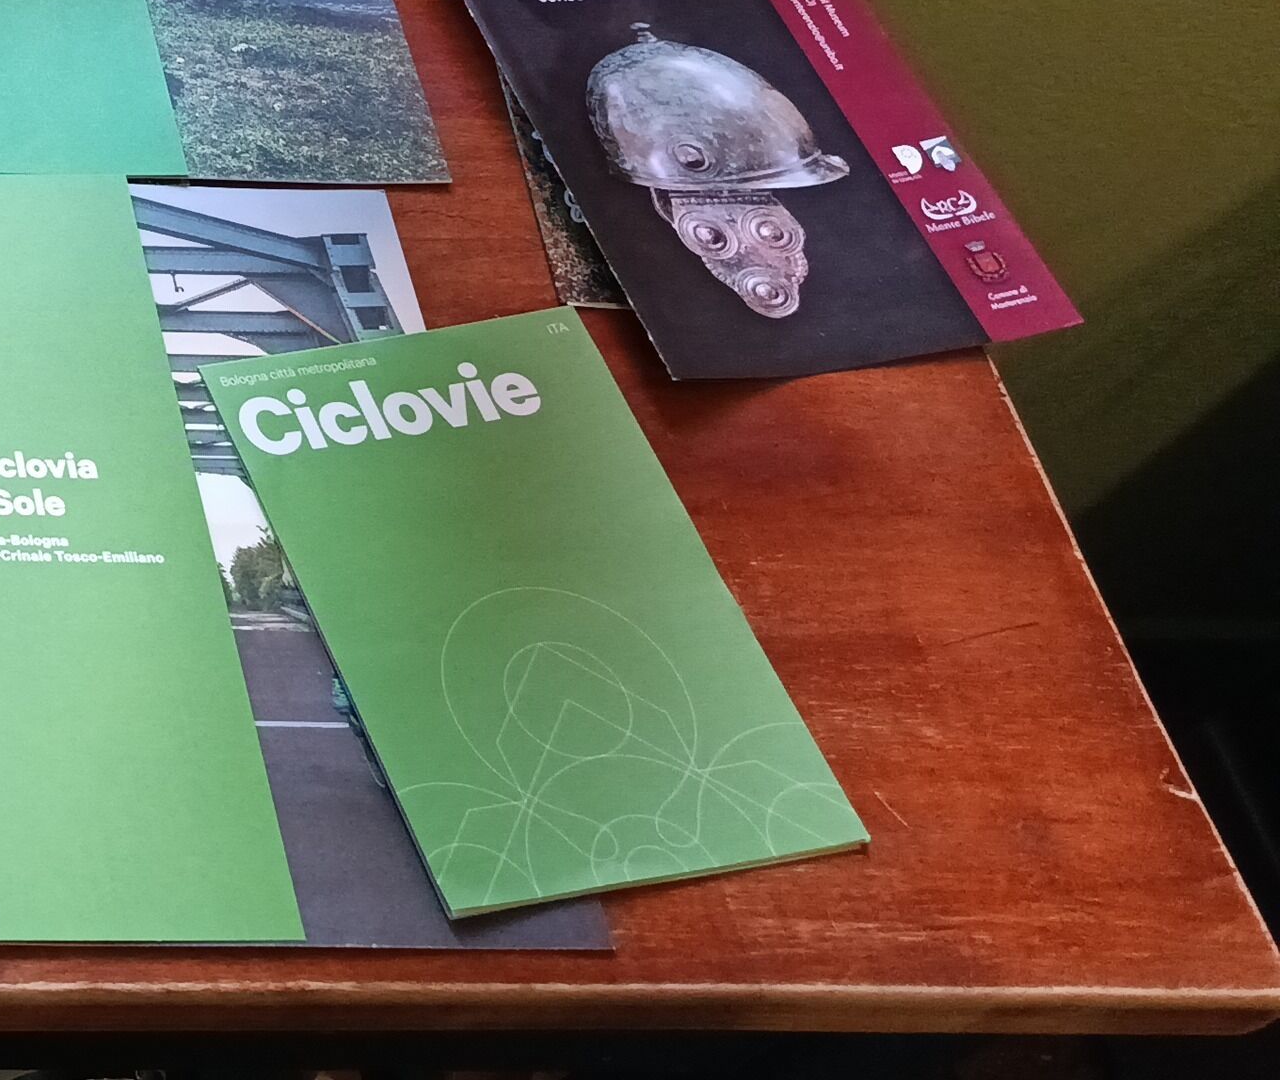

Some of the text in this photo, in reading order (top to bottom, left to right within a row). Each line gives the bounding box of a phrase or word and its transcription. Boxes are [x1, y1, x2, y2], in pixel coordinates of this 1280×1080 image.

[961, 211, 997, 226] Bibele
[547, 322, 571, 336] ITA
[219, 355, 377, 388] Bologna città metropolitana
[238, 361, 542, 456] Ciclovie
[53, 550, 166, 564] Tosco-Emiliano
